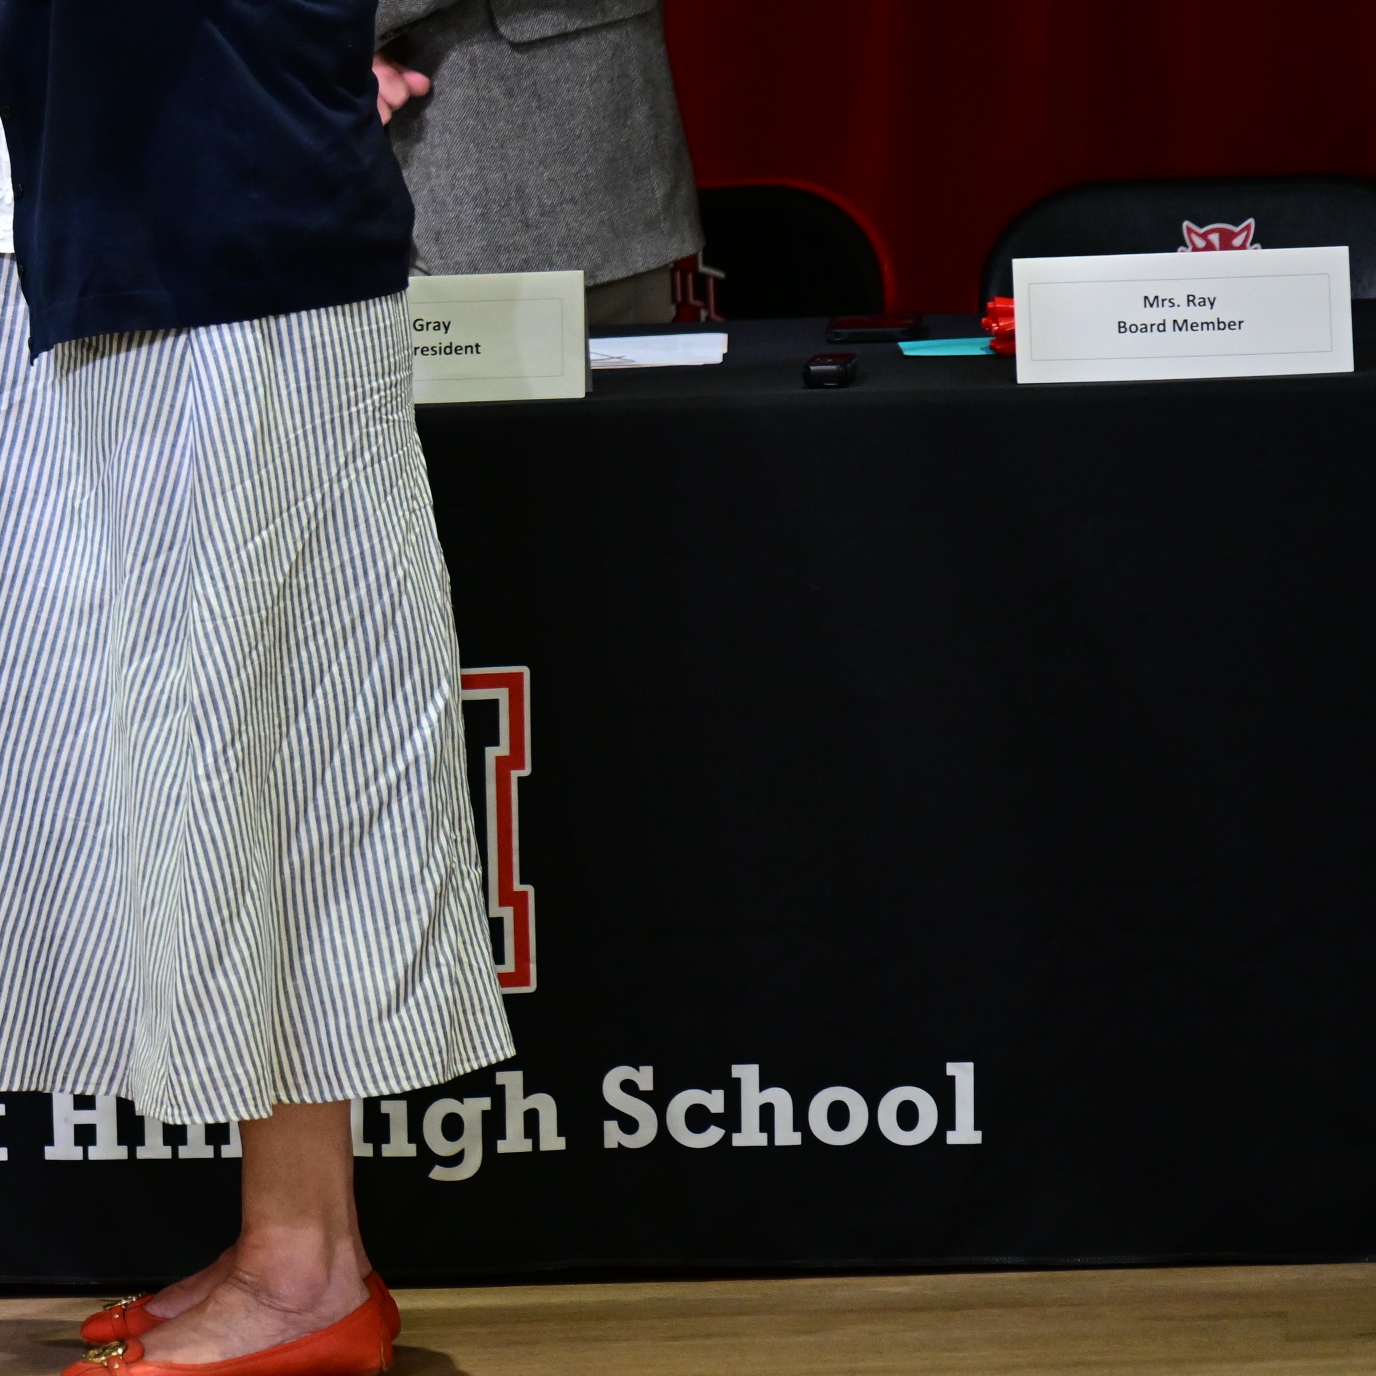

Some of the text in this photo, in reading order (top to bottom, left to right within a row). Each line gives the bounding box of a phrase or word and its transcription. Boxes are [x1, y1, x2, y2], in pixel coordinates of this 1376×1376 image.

[1143, 294, 1217, 310] Mrs. Ray
[412, 318, 451, 335] Gray
[1117, 317, 1245, 334] Board Member
[413, 341, 481, 356] resident
[44, 1091, 242, 1161] Hi
[600, 1061, 983, 1149] School
